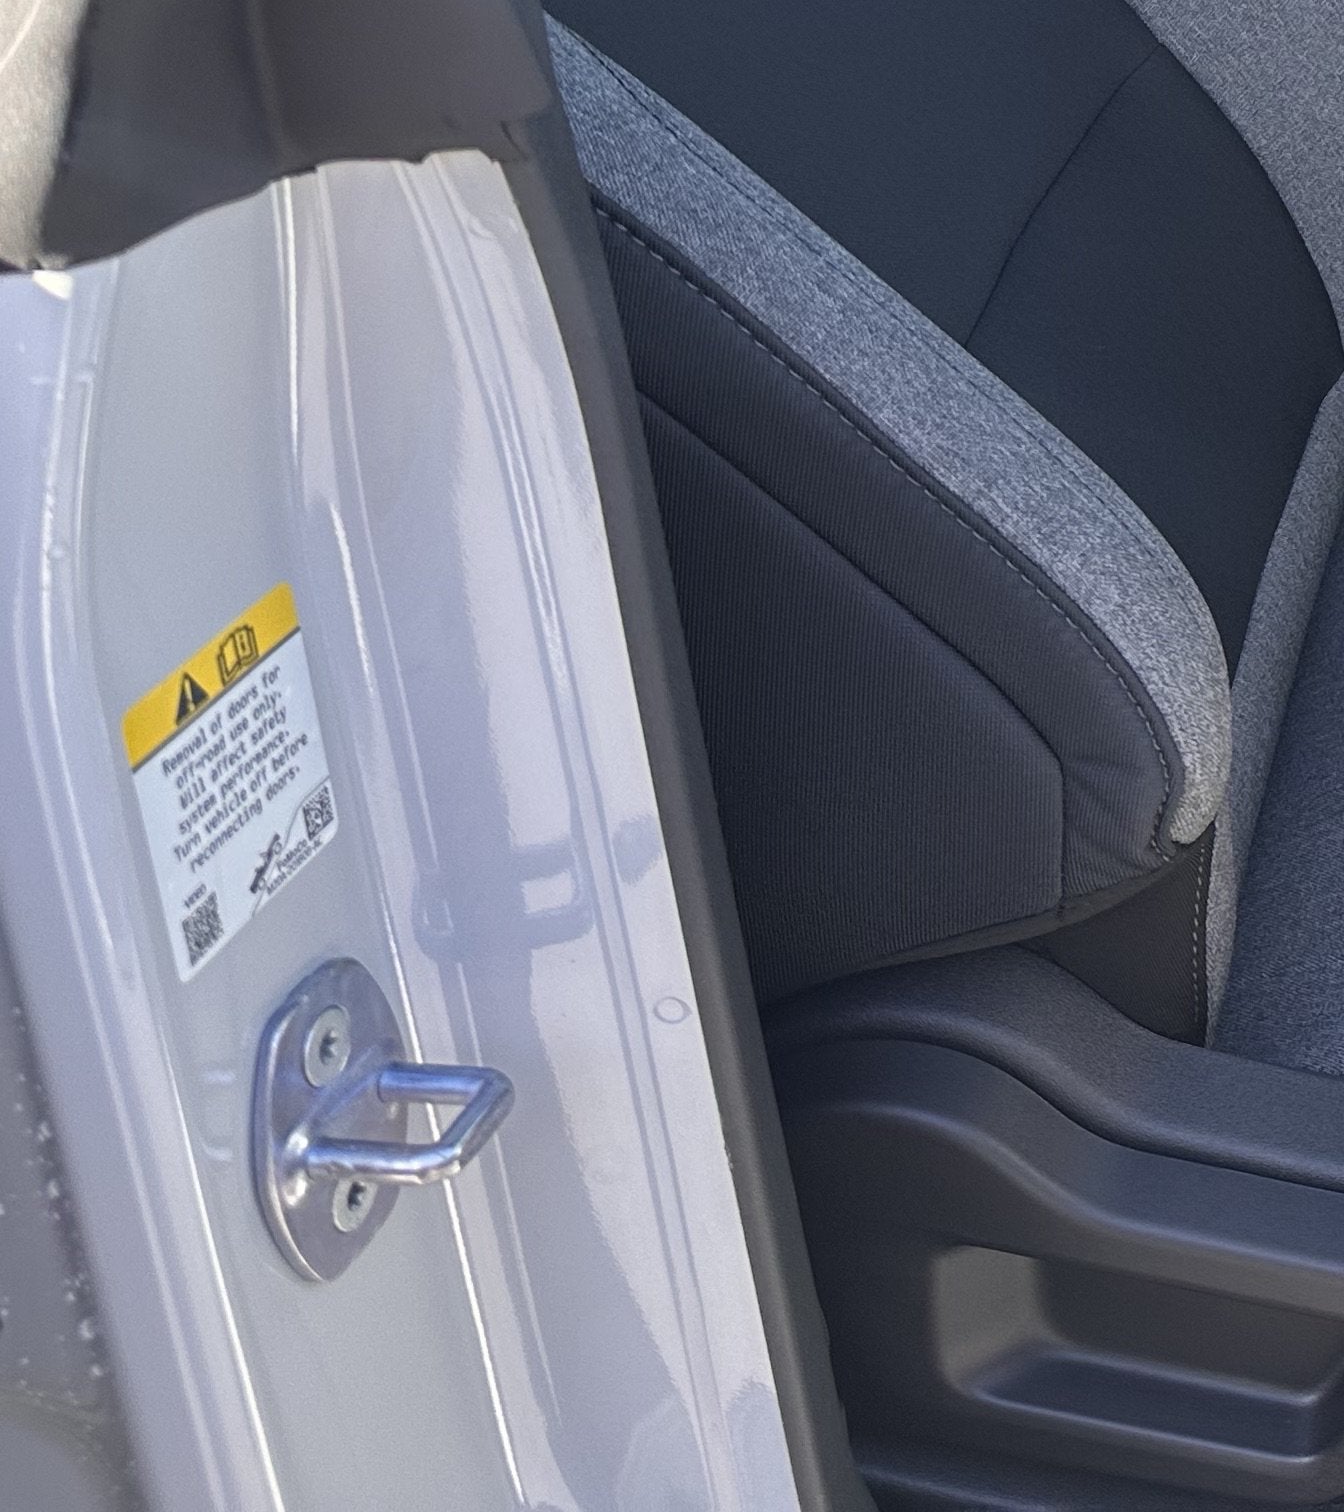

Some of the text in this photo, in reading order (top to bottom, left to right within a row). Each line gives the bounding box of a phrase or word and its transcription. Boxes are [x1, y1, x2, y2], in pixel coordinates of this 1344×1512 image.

[161, 665, 281, 778] Removal of doors for
[175, 736, 227, 789] off-road
[229, 717, 249, 741] use
[179, 705, 287, 810] Will affect safety
[173, 732, 309, 862] Turn vehicle off before
[178, 792, 217, 835] system
[189, 797, 264, 874] reconnecting
